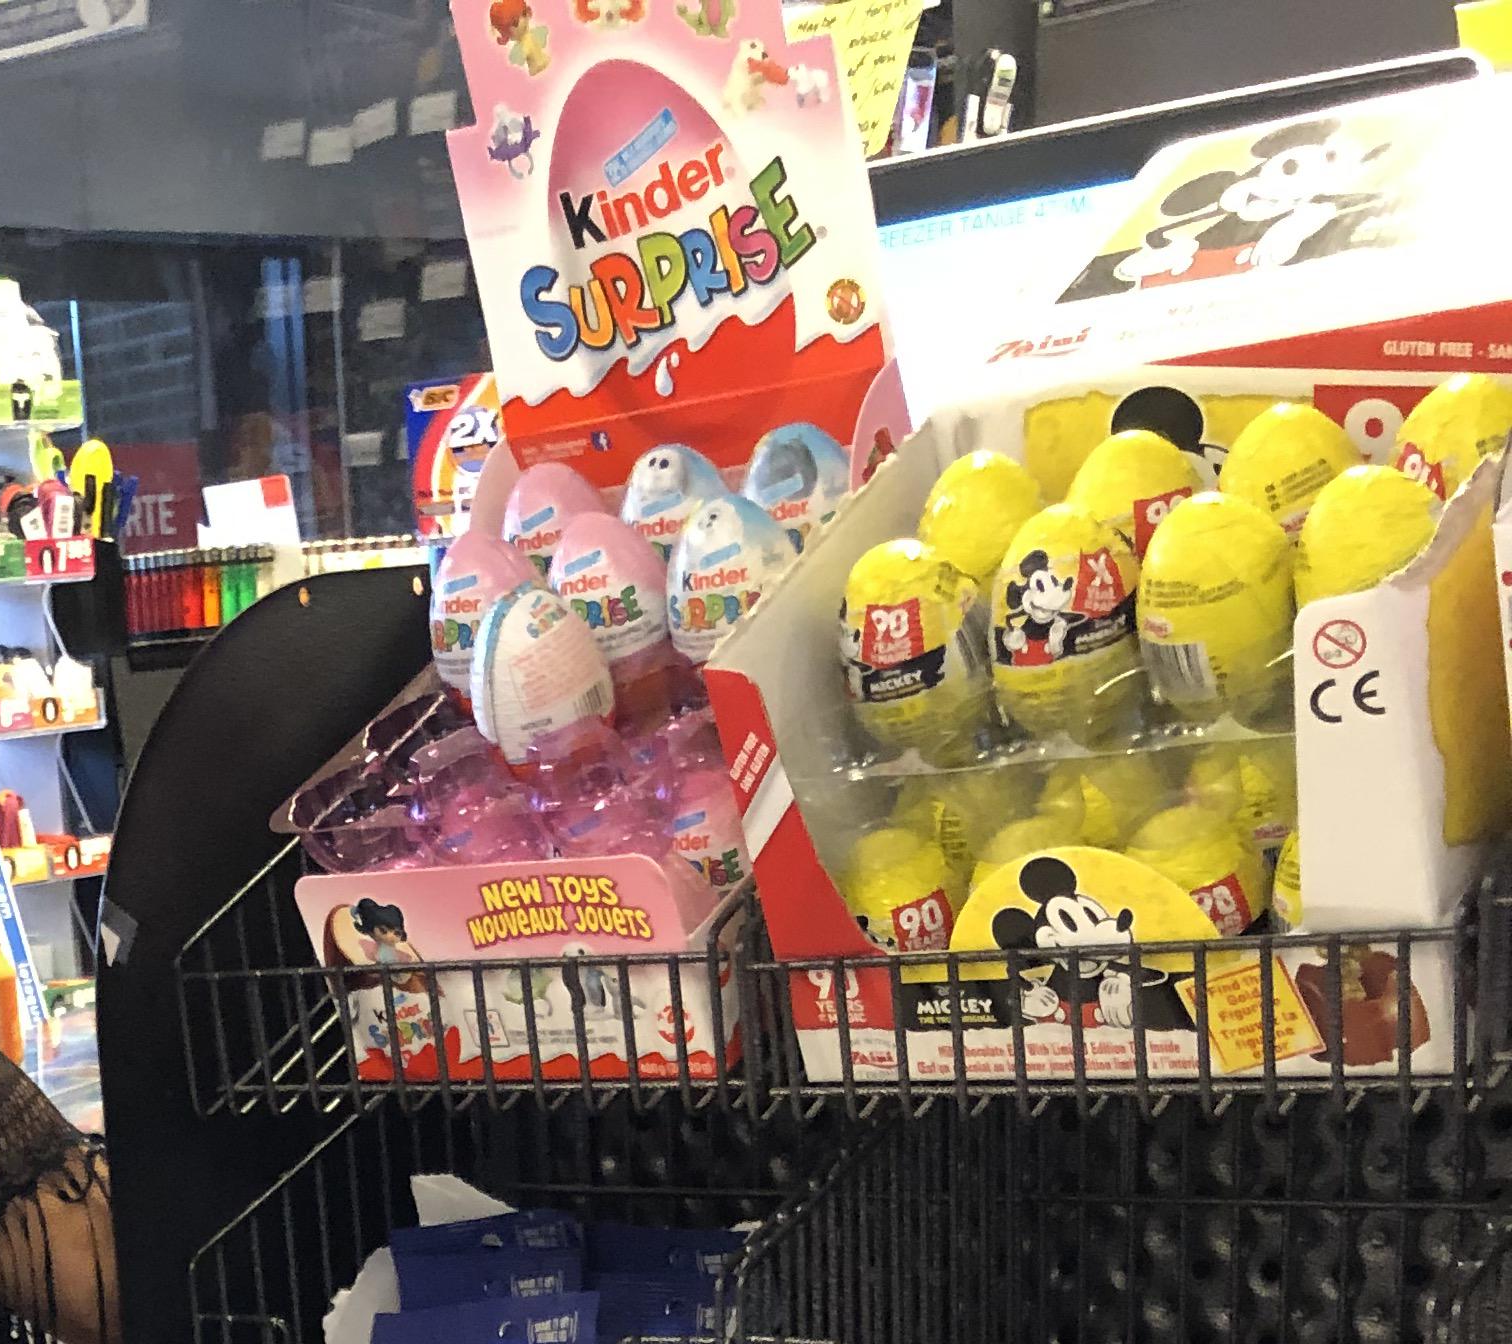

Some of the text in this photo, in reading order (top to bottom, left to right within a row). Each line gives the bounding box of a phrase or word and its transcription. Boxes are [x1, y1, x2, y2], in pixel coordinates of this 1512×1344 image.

[559, 143, 725, 250] Kinder
[520, 156, 817, 362] SURPRISE
[682, 566, 749, 592] Kinder
[870, 608, 910, 640] 90
[548, 874, 619, 907] TOYS
[468, 906, 652, 946] NOUVEAUX JOUETS
[897, 898, 945, 938] 90
